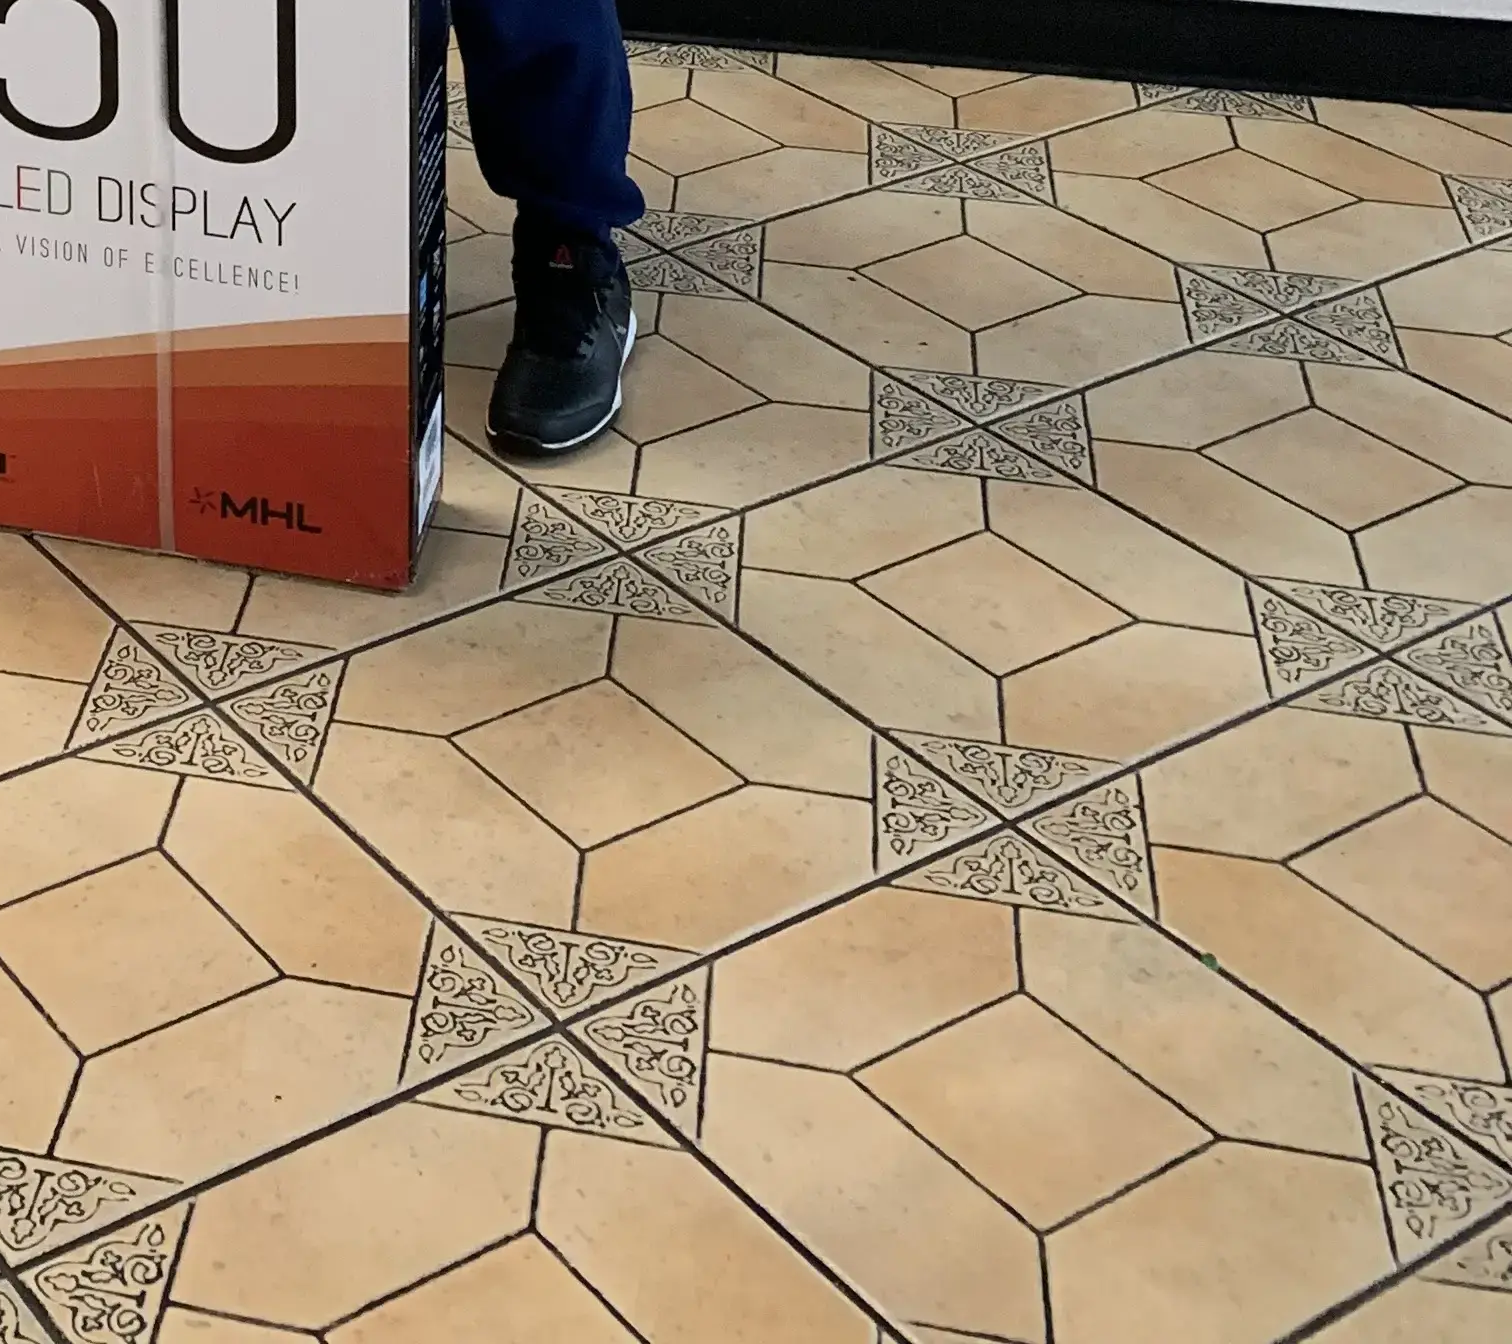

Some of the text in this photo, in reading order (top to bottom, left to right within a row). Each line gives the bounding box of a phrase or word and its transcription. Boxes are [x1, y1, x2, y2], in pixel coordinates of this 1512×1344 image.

[98, 174, 298, 248] DISPLAY
[15, 232, 89, 264] VISION
[103, 246, 129, 269] OF
[144, 251, 301, 295] ECELLENCE!
[221, 491, 323, 534] MHL
